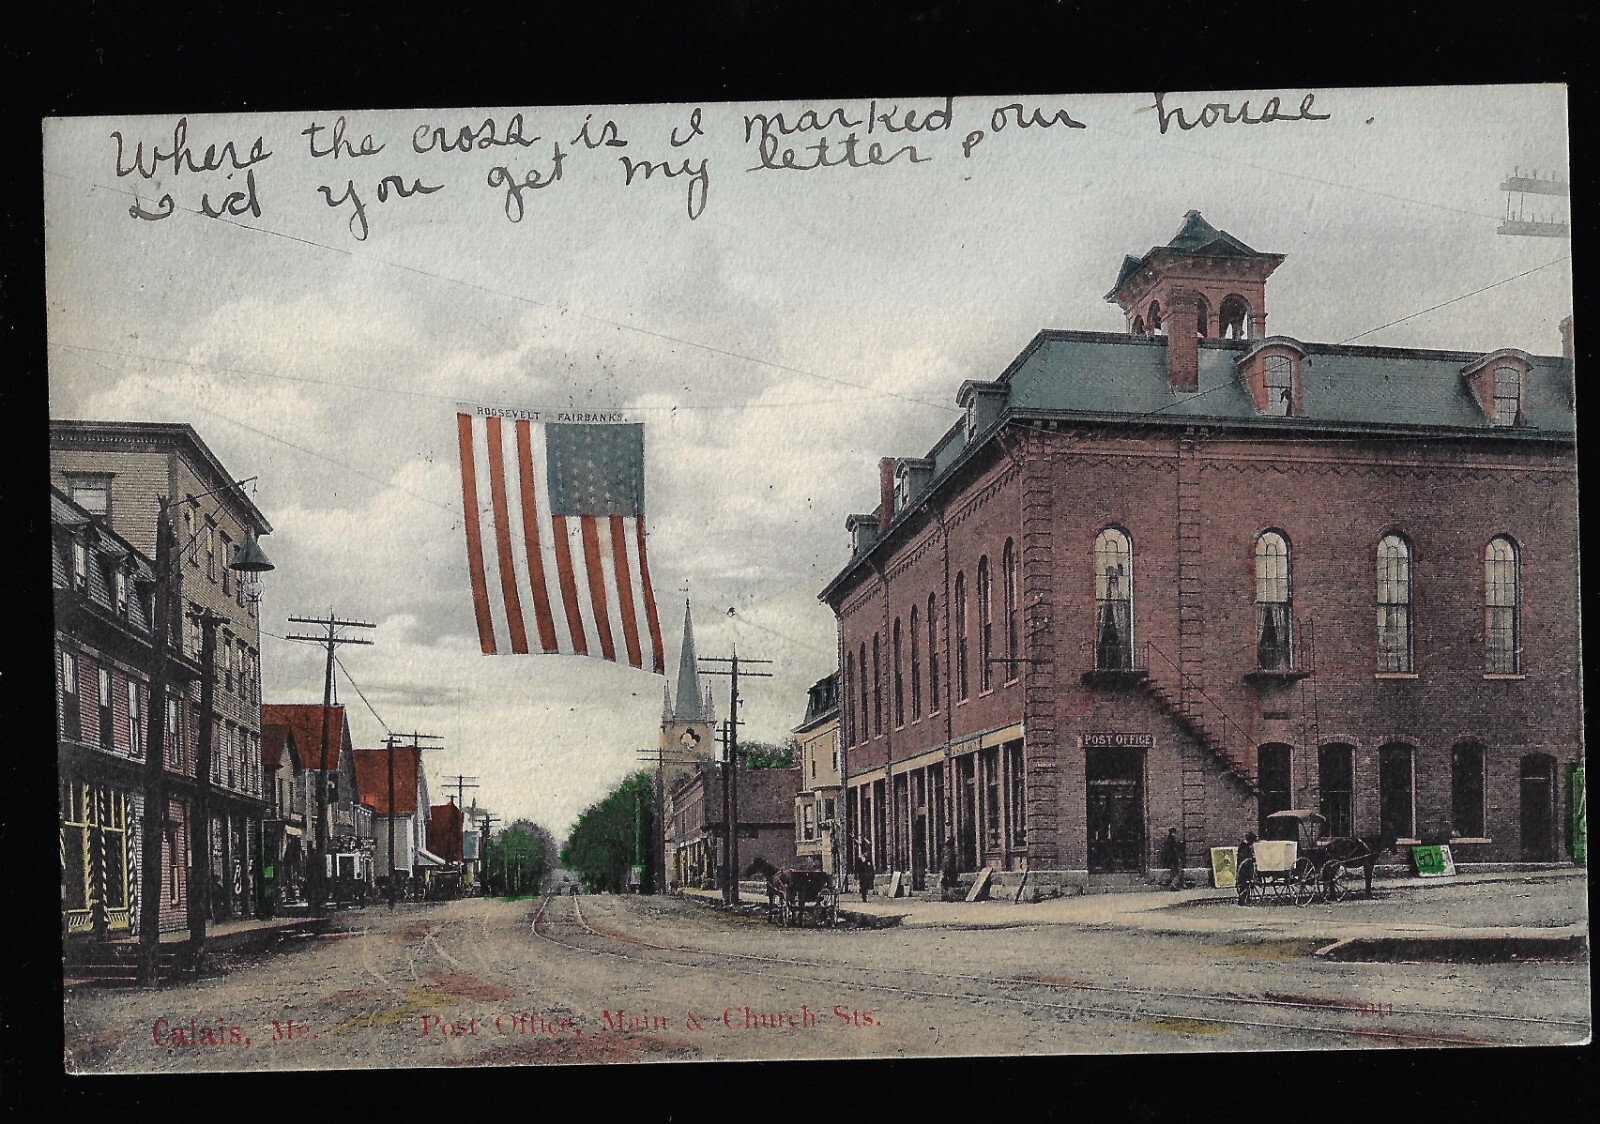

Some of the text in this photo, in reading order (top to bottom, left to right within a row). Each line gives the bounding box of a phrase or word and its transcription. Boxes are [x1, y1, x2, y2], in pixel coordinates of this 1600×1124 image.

[109, 114, 274, 178] Where
[300, 115, 386, 158] the
[412, 112, 542, 154] cross
[570, 113, 629, 150] is
[743, 97, 955, 142] marked
[990, 102, 1088, 131] our
[318, 176, 444, 240] you
[487, 140, 566, 224] get
[620, 150, 710, 222] my
[476, 406, 541, 420] ROOSEVELT
[1085, 734, 1152, 745] POST OFFICE
